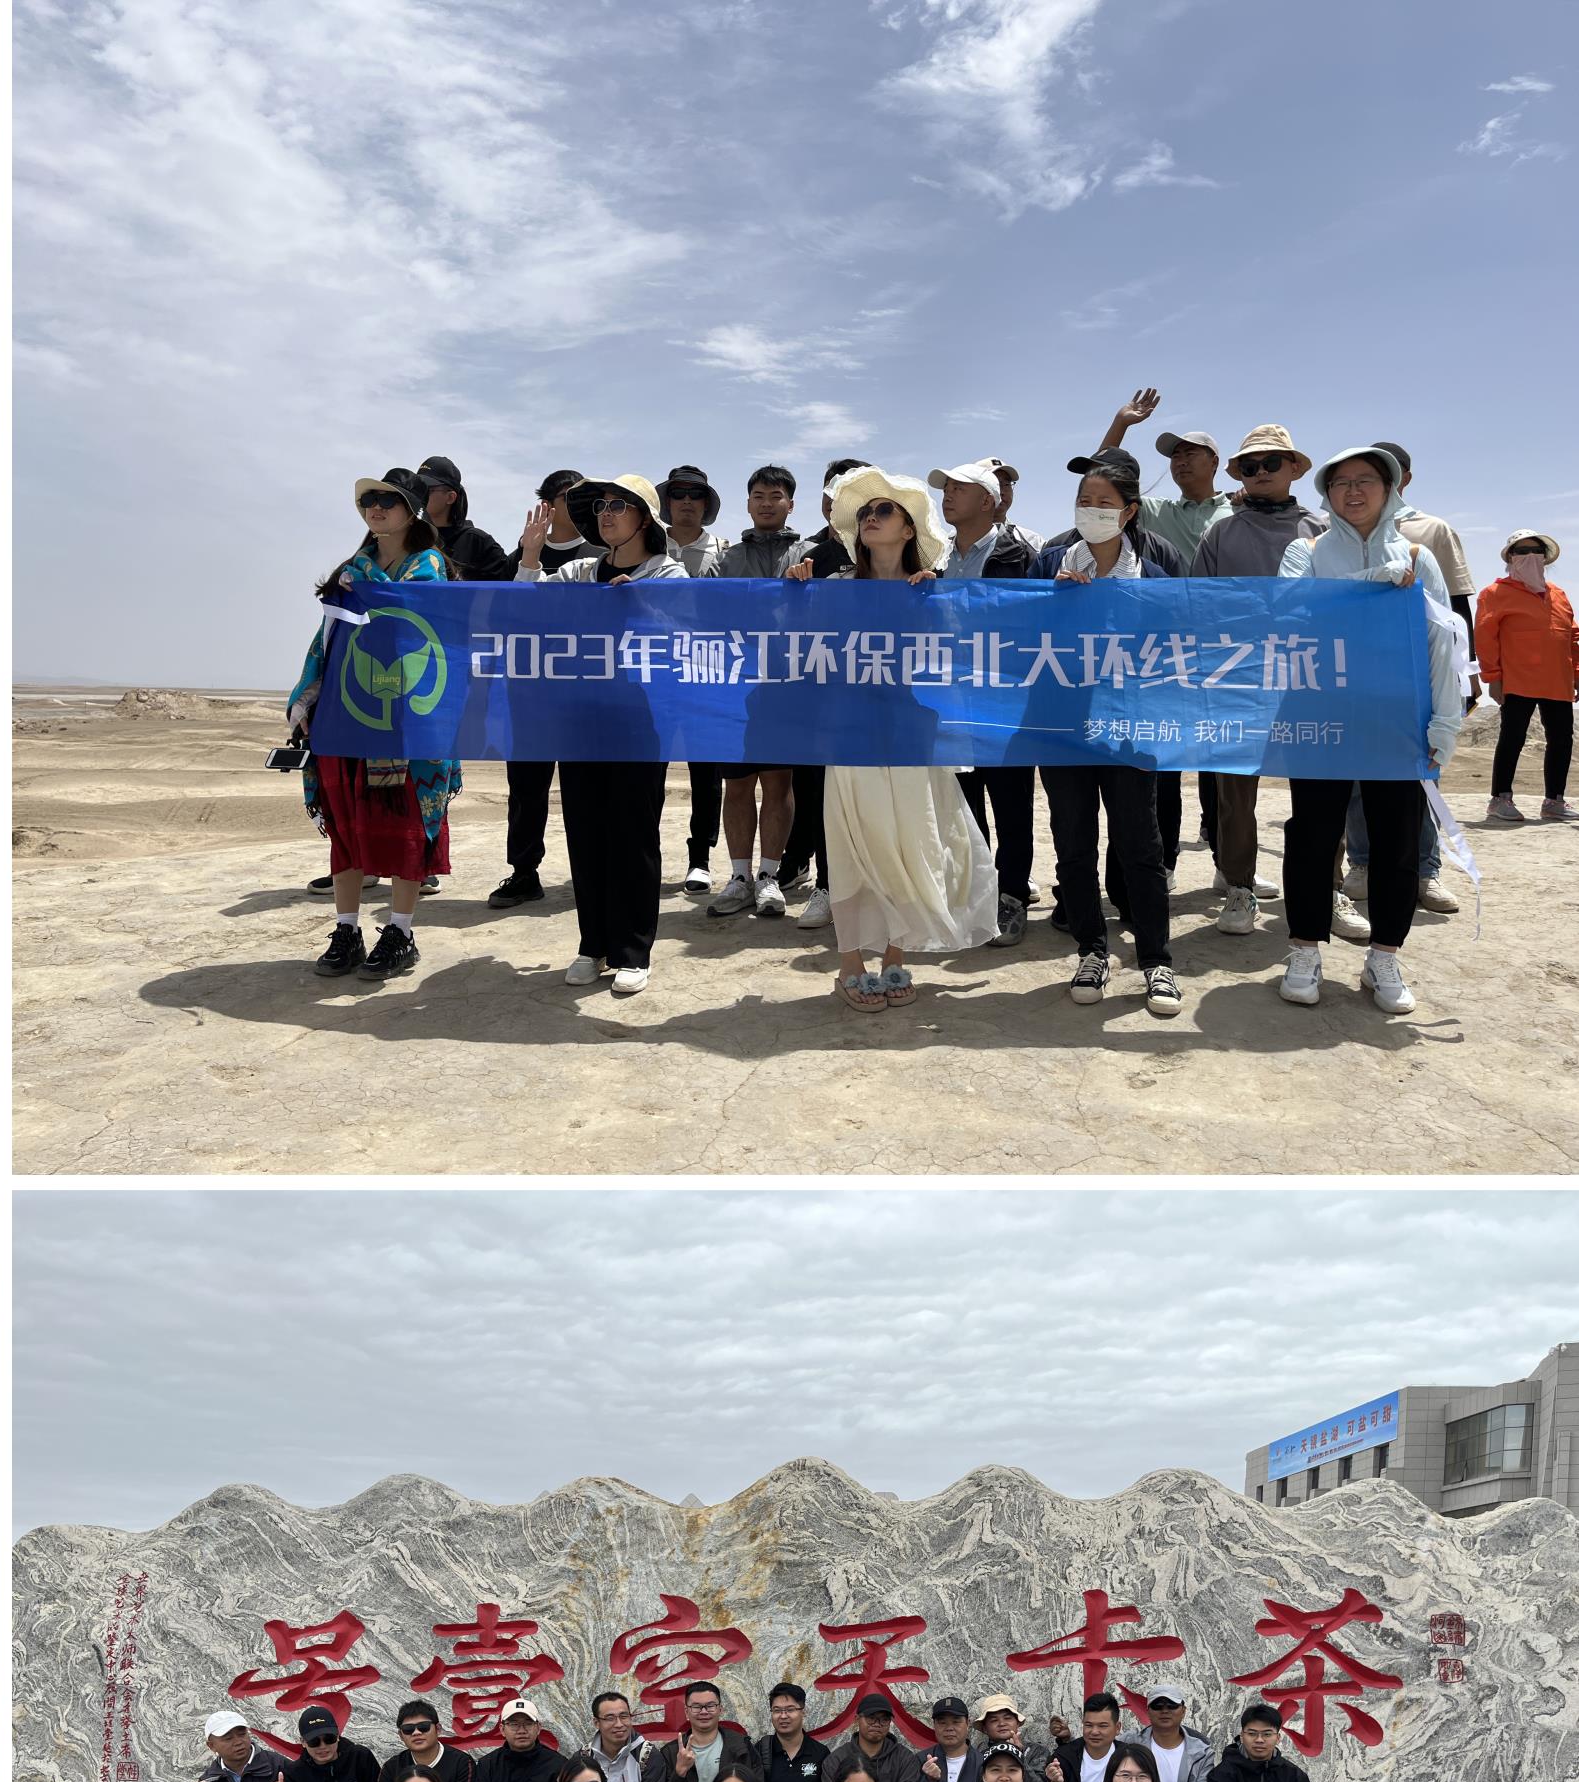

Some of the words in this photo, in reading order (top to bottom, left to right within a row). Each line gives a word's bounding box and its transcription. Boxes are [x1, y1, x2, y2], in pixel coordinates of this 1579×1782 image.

[470, 630, 1347, 691] 2023年骊江环保西北大环线之旅！
[372, 673, 401, 687] Lijiang
[1082, 717, 1182, 743] 梦想启航
[1194, 718, 1345, 745] 我们一路同行
